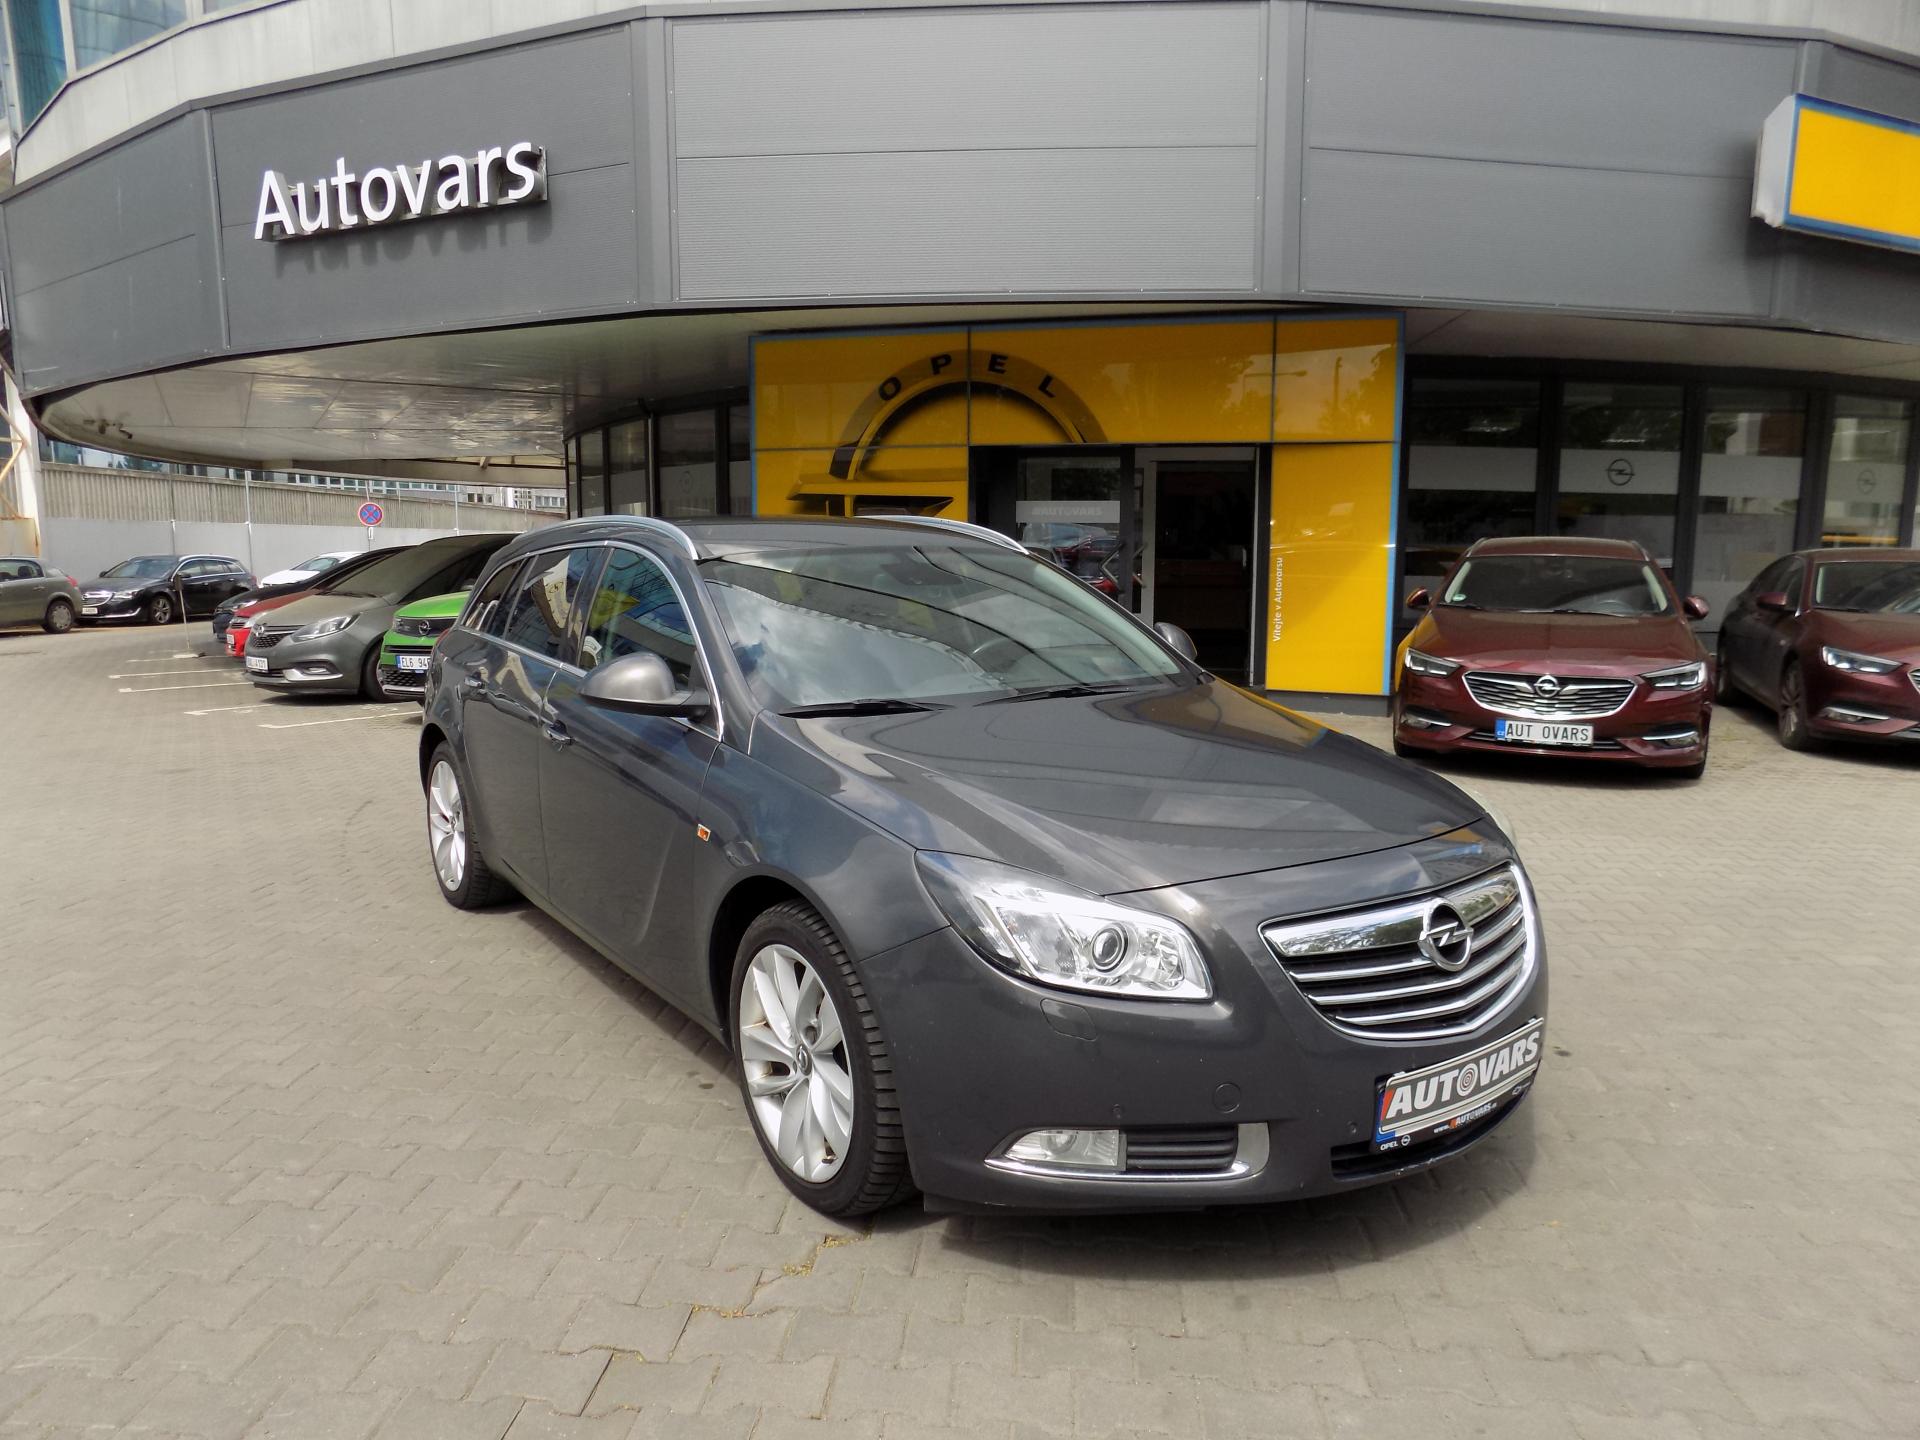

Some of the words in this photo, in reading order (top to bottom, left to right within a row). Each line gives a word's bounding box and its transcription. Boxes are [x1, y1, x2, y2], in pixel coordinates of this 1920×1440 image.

[254, 141, 540, 240] Autovars
[879, 353, 1056, 401] OPEL
[1274, 558, 1283, 603] Autovarsu
[1506, 723, 1533, 737] AUT
[1542, 726, 1589, 741] OVARS
[1386, 1031, 1540, 1119] AUTOVARS
[1380, 1141, 1398, 1151] OPEL
